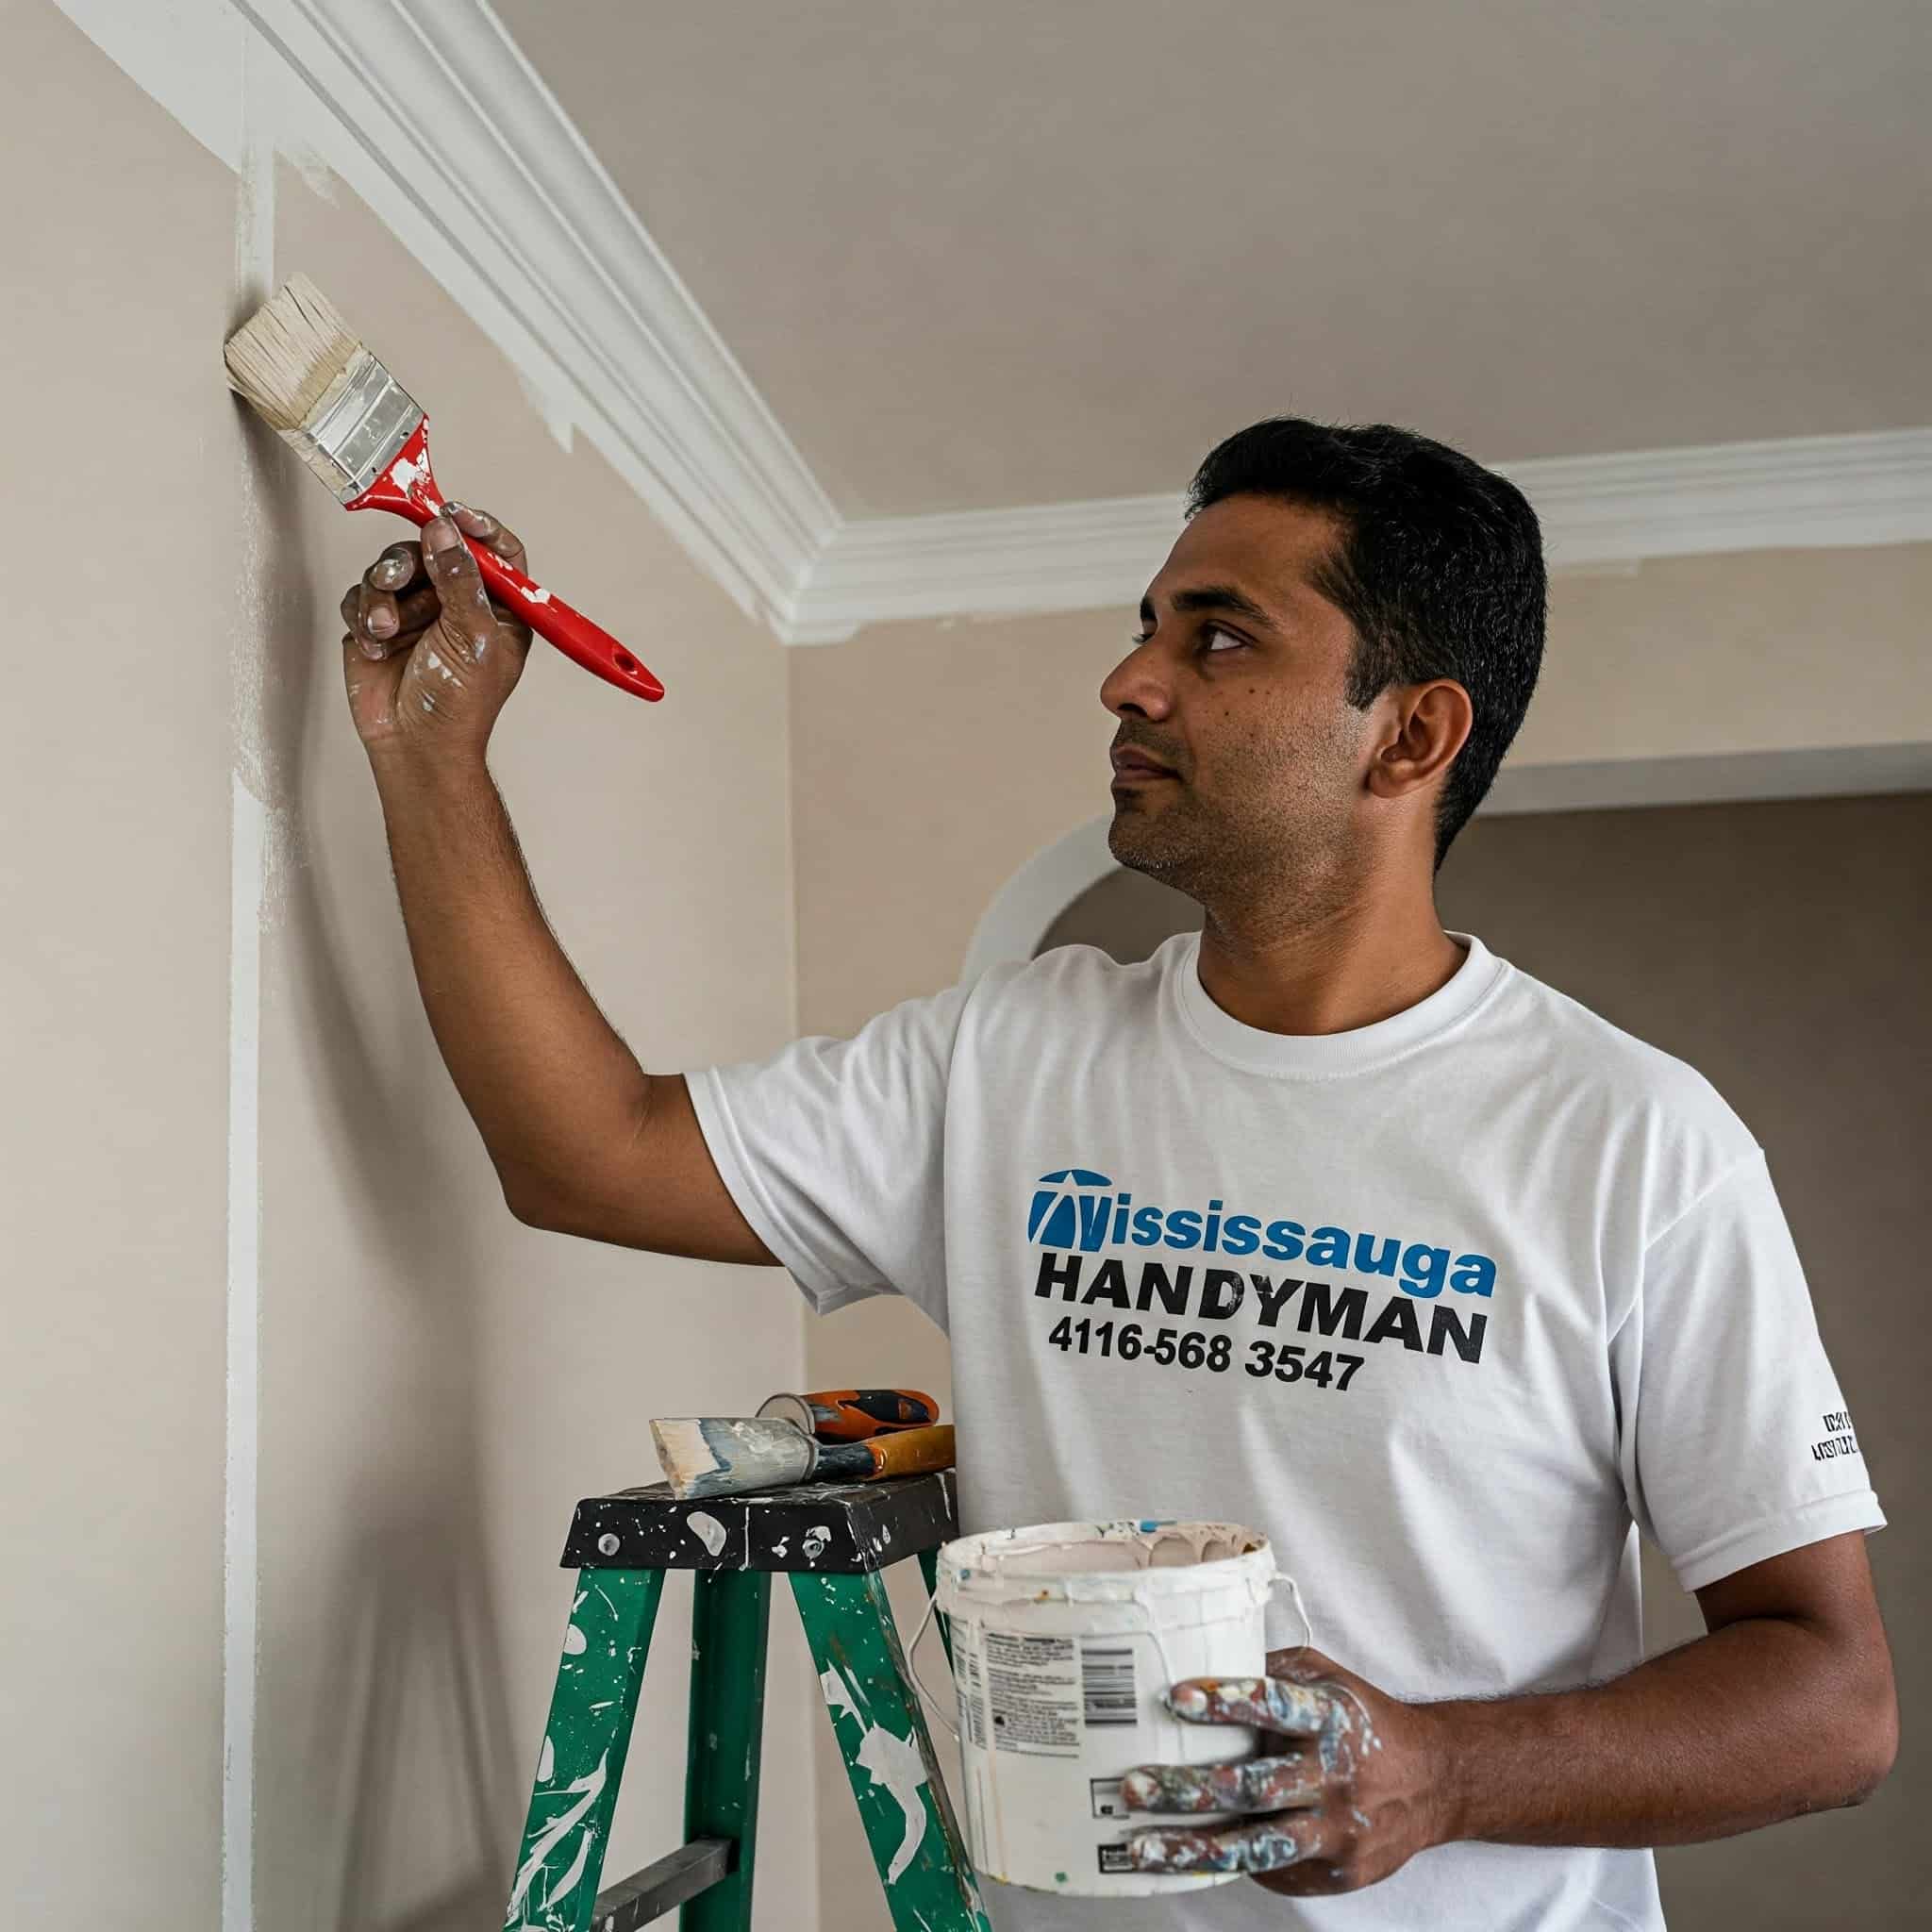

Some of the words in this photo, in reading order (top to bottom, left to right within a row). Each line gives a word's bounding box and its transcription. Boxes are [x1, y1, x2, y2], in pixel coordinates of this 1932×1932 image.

[1034, 1252, 1489, 1364] HANDYMAN
[1048, 1316, 1232, 1373] 4116-568
[1244, 1340, 1365, 1391] 3547
